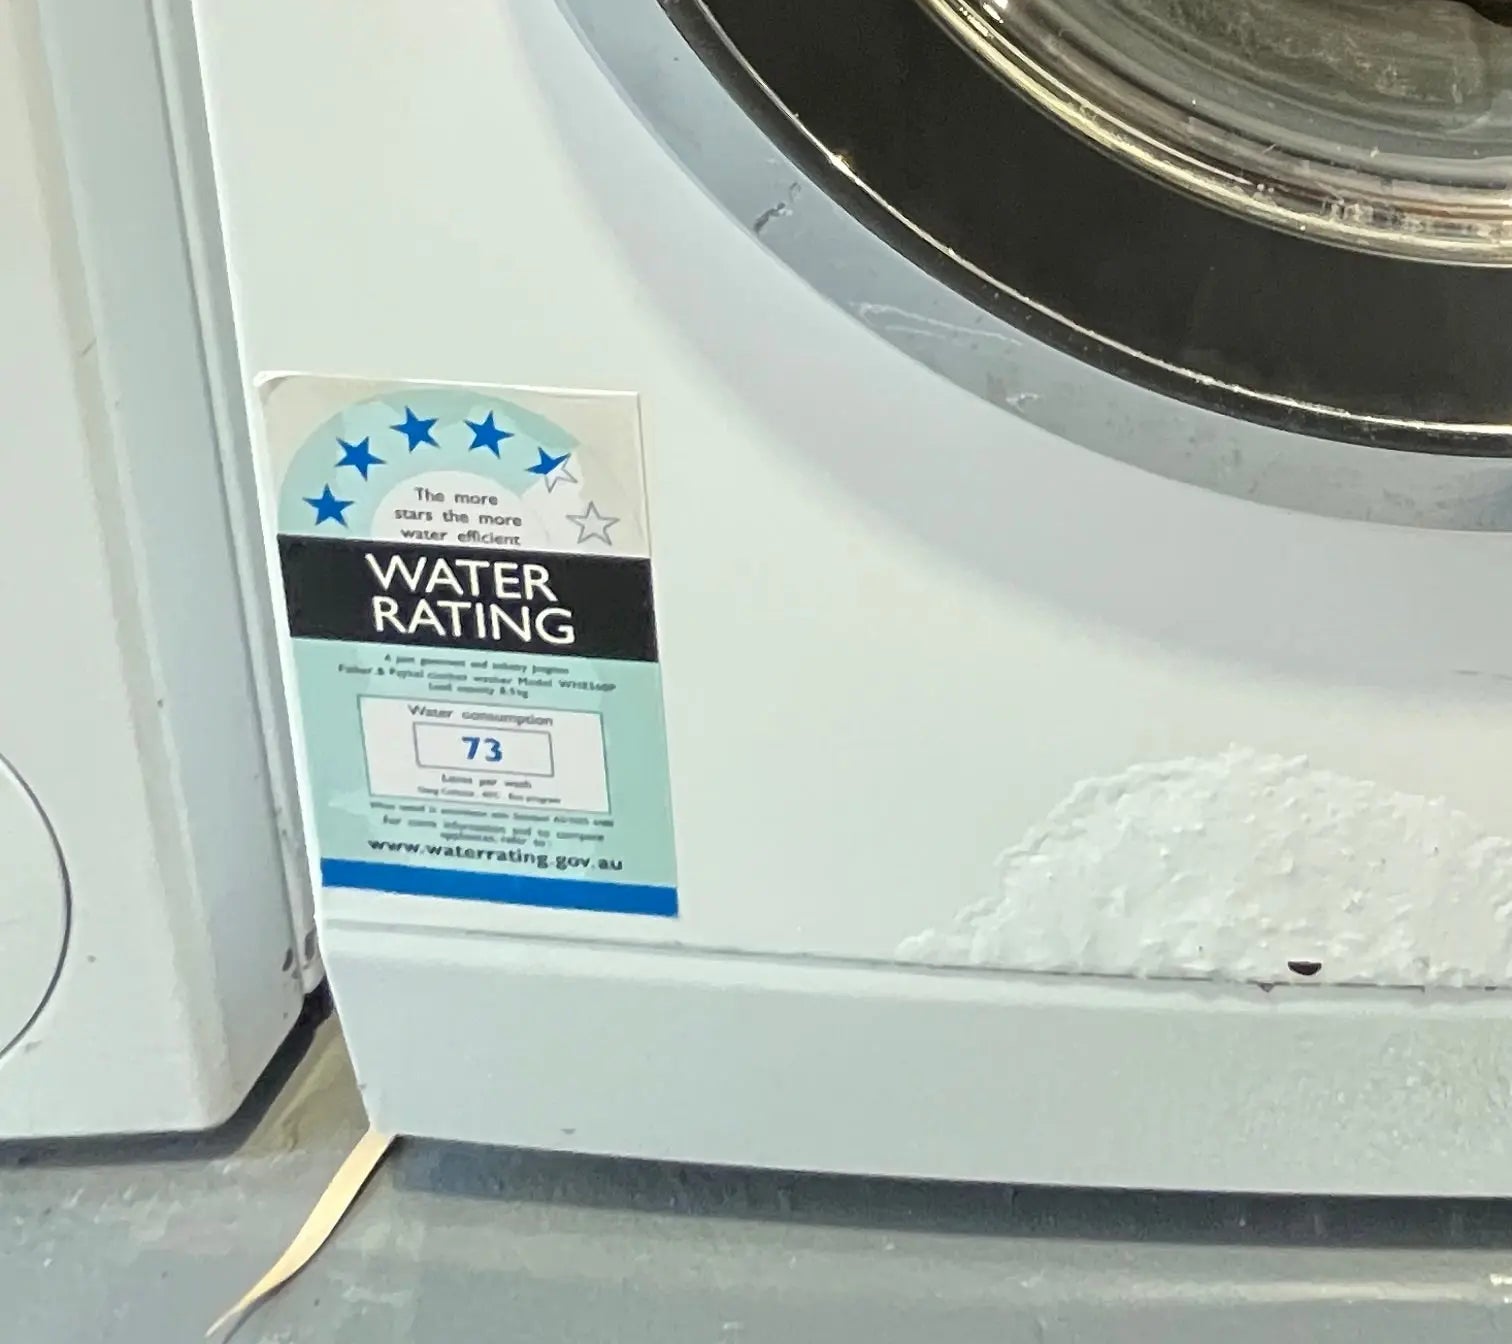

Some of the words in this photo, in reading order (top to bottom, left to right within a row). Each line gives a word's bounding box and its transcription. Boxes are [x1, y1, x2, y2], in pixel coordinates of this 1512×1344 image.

[414, 486, 445, 503] The
[453, 491, 499, 507] more
[393, 508, 434, 523] stars
[442, 509, 470, 524] the
[478, 514, 523, 528] more
[400, 526, 448, 542] water
[457, 528, 522, 546] efficient
[364, 553, 558, 602] WATER
[371, 595, 576, 645] RATING
[408, 704, 454, 719] Water
[461, 710, 554, 727] consumption
[461, 735, 504, 763] 73
[367, 839, 624, 872] www.waterrating.gov.au
